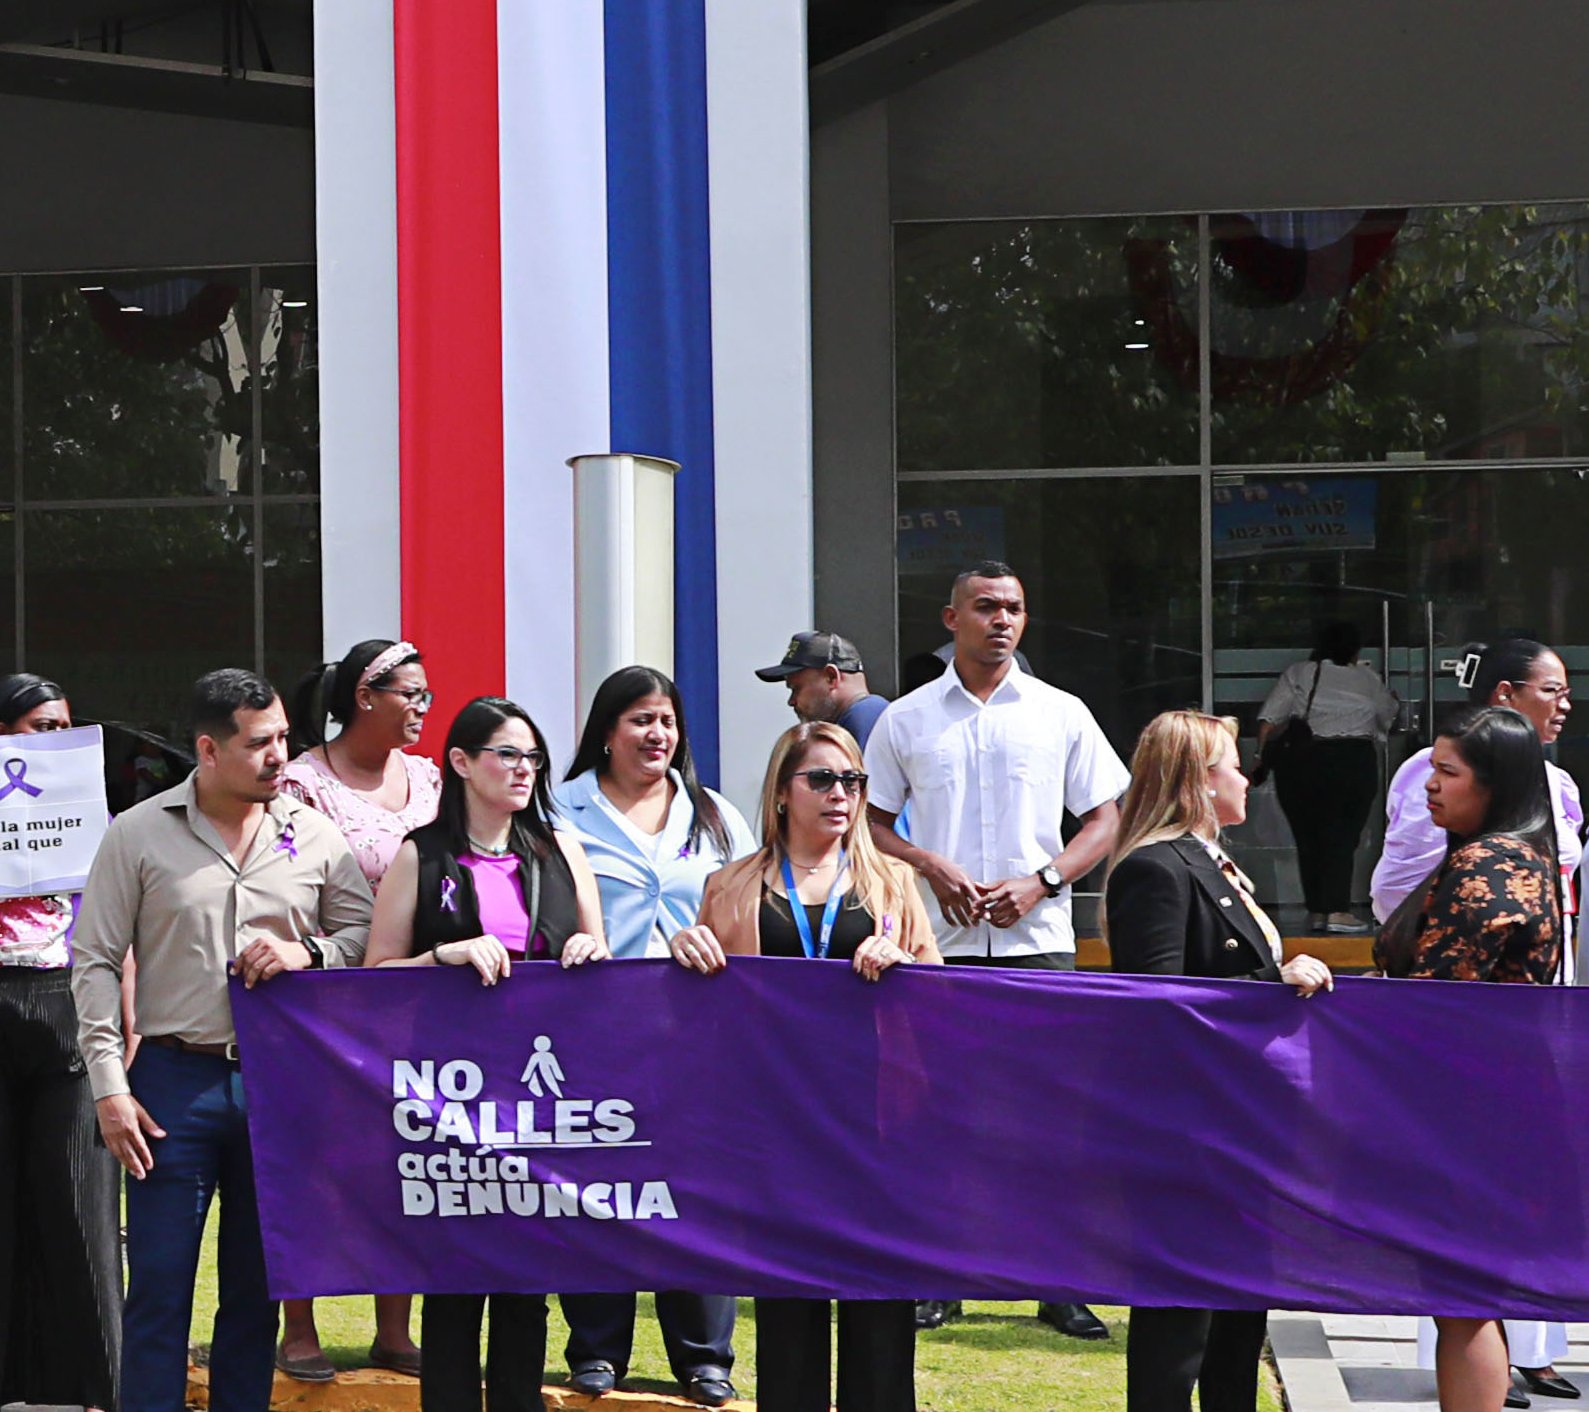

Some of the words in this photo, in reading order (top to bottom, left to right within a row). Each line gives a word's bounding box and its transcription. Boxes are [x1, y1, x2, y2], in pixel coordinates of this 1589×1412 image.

[1, 821, 18, 833] la
[26, 817, 82, 832] mujer
[27, 837, 63, 851] que
[393, 1059, 483, 1101] NO
[393, 1098, 636, 1145] CALLES
[397, 1144, 530, 1181] actúa
[401, 1179, 679, 1220] DENUNCIA
